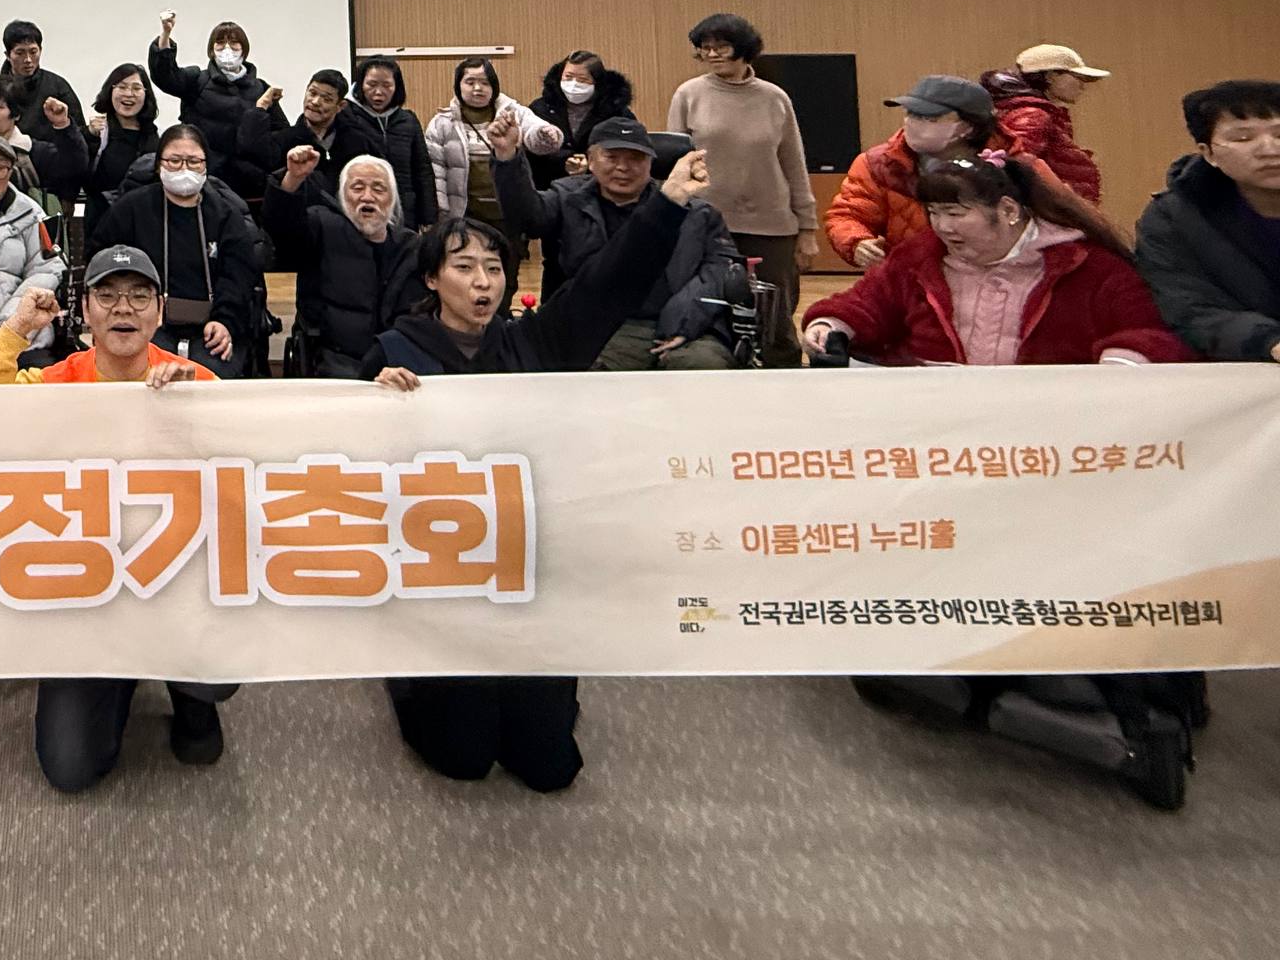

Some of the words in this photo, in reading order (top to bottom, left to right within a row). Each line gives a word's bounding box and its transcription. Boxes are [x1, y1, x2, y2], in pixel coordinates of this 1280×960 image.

[731, 448, 856, 481] 2026년
[864, 447, 921, 480] 2월
[927, 444, 1061, 479] 24일(화)
[1069, 442, 1128, 474] 오후
[1133, 440, 1186, 471] 2시
[740, 522, 860, 556] 이룸센터
[869, 518, 957, 552] 누리홀
[738, 598, 1223, 626] 전국권리중심중증장애인맞춤형공공일자리협회
